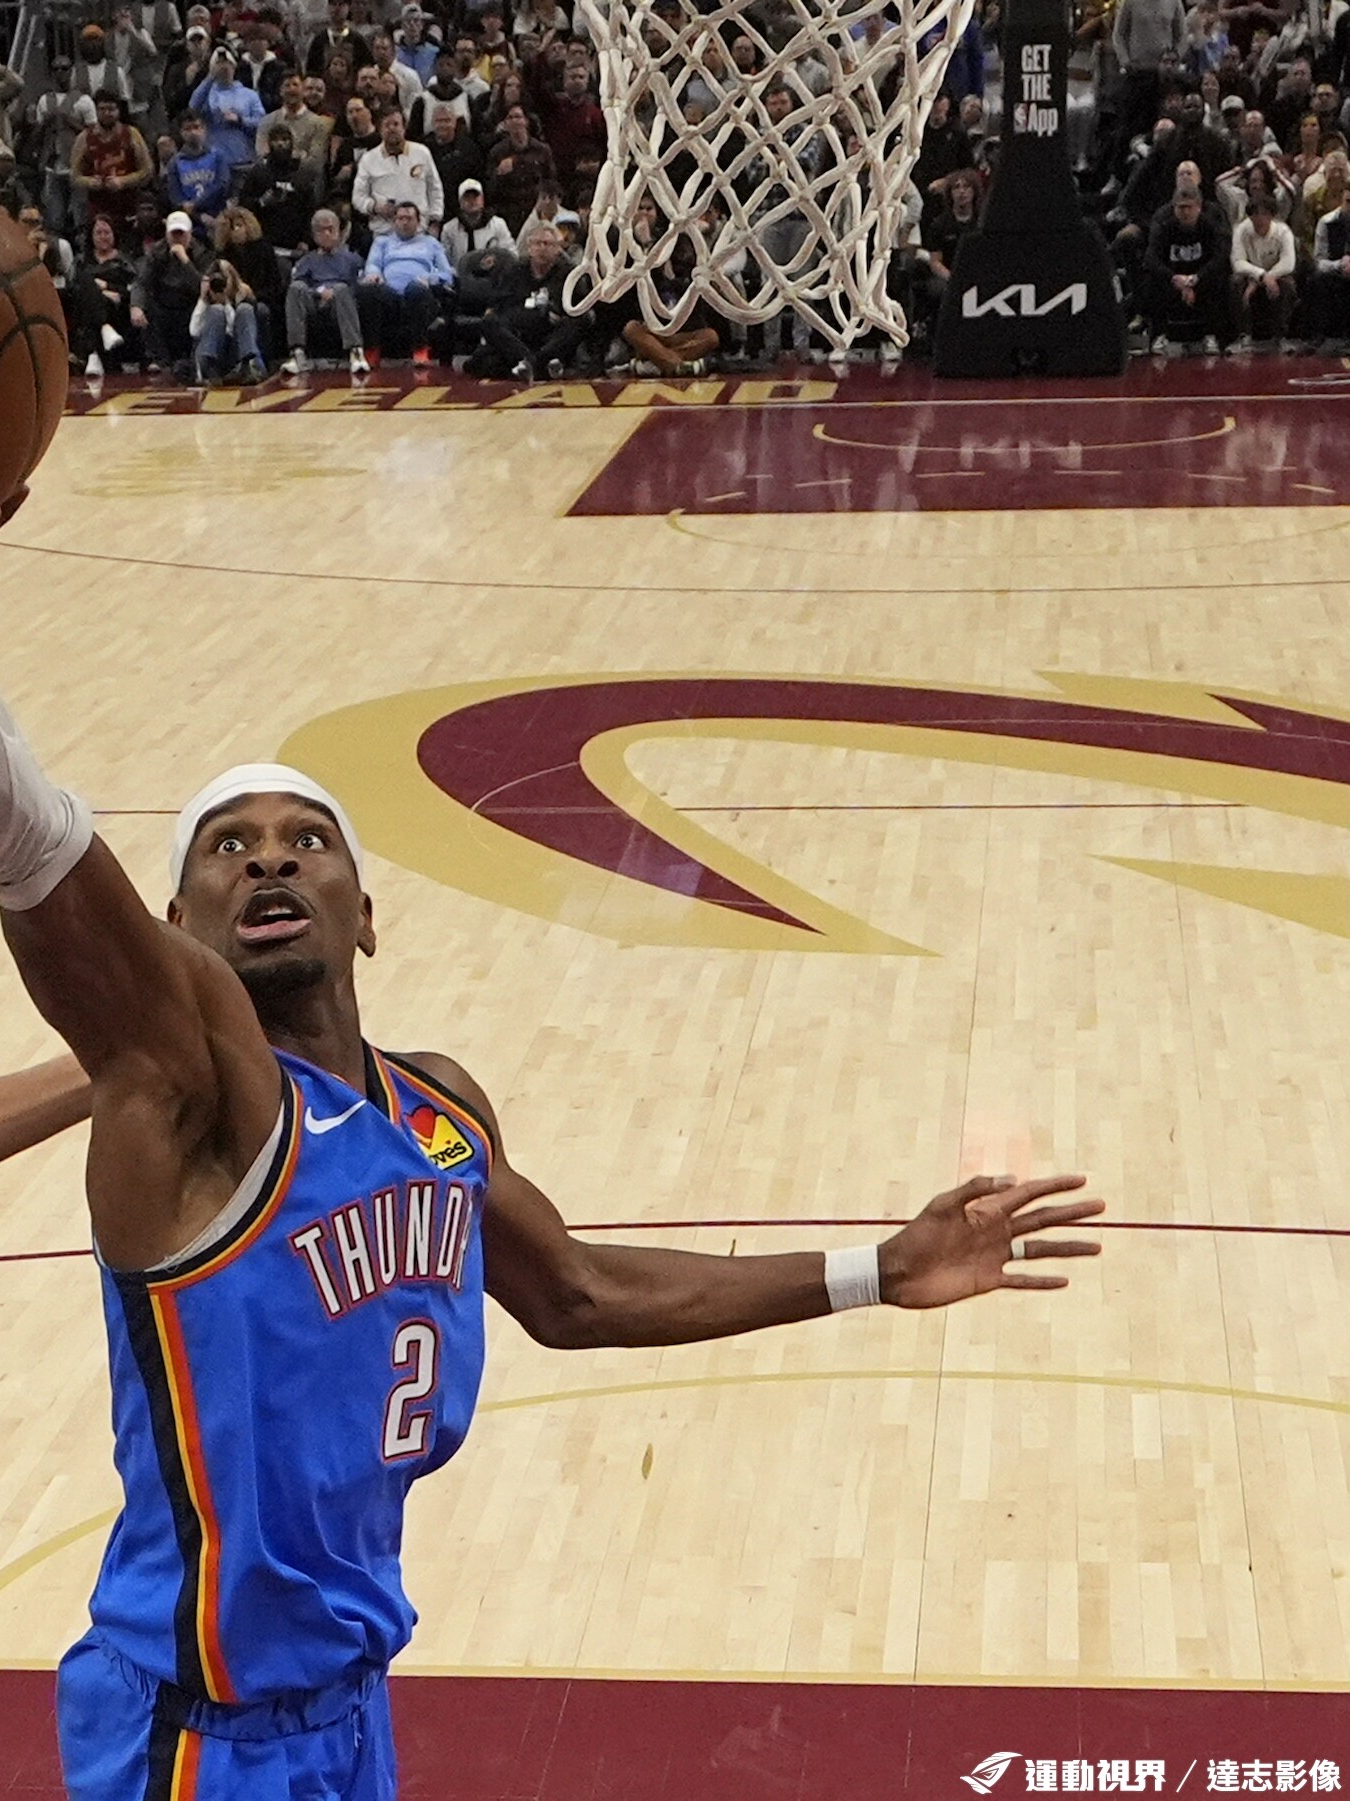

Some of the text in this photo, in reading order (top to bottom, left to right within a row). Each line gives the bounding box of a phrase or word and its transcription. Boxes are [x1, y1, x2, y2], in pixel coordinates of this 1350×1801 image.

[1021, 44, 1052, 72] GET
[1021, 73, 1052, 101] THE
[1027, 103, 1059, 137] App
[962, 283, 1088, 318] KIA
[61, 380, 839, 416] EVELAND
[289, 1179, 474, 1321] THUND
[382, 1317, 440, 1462] 2
